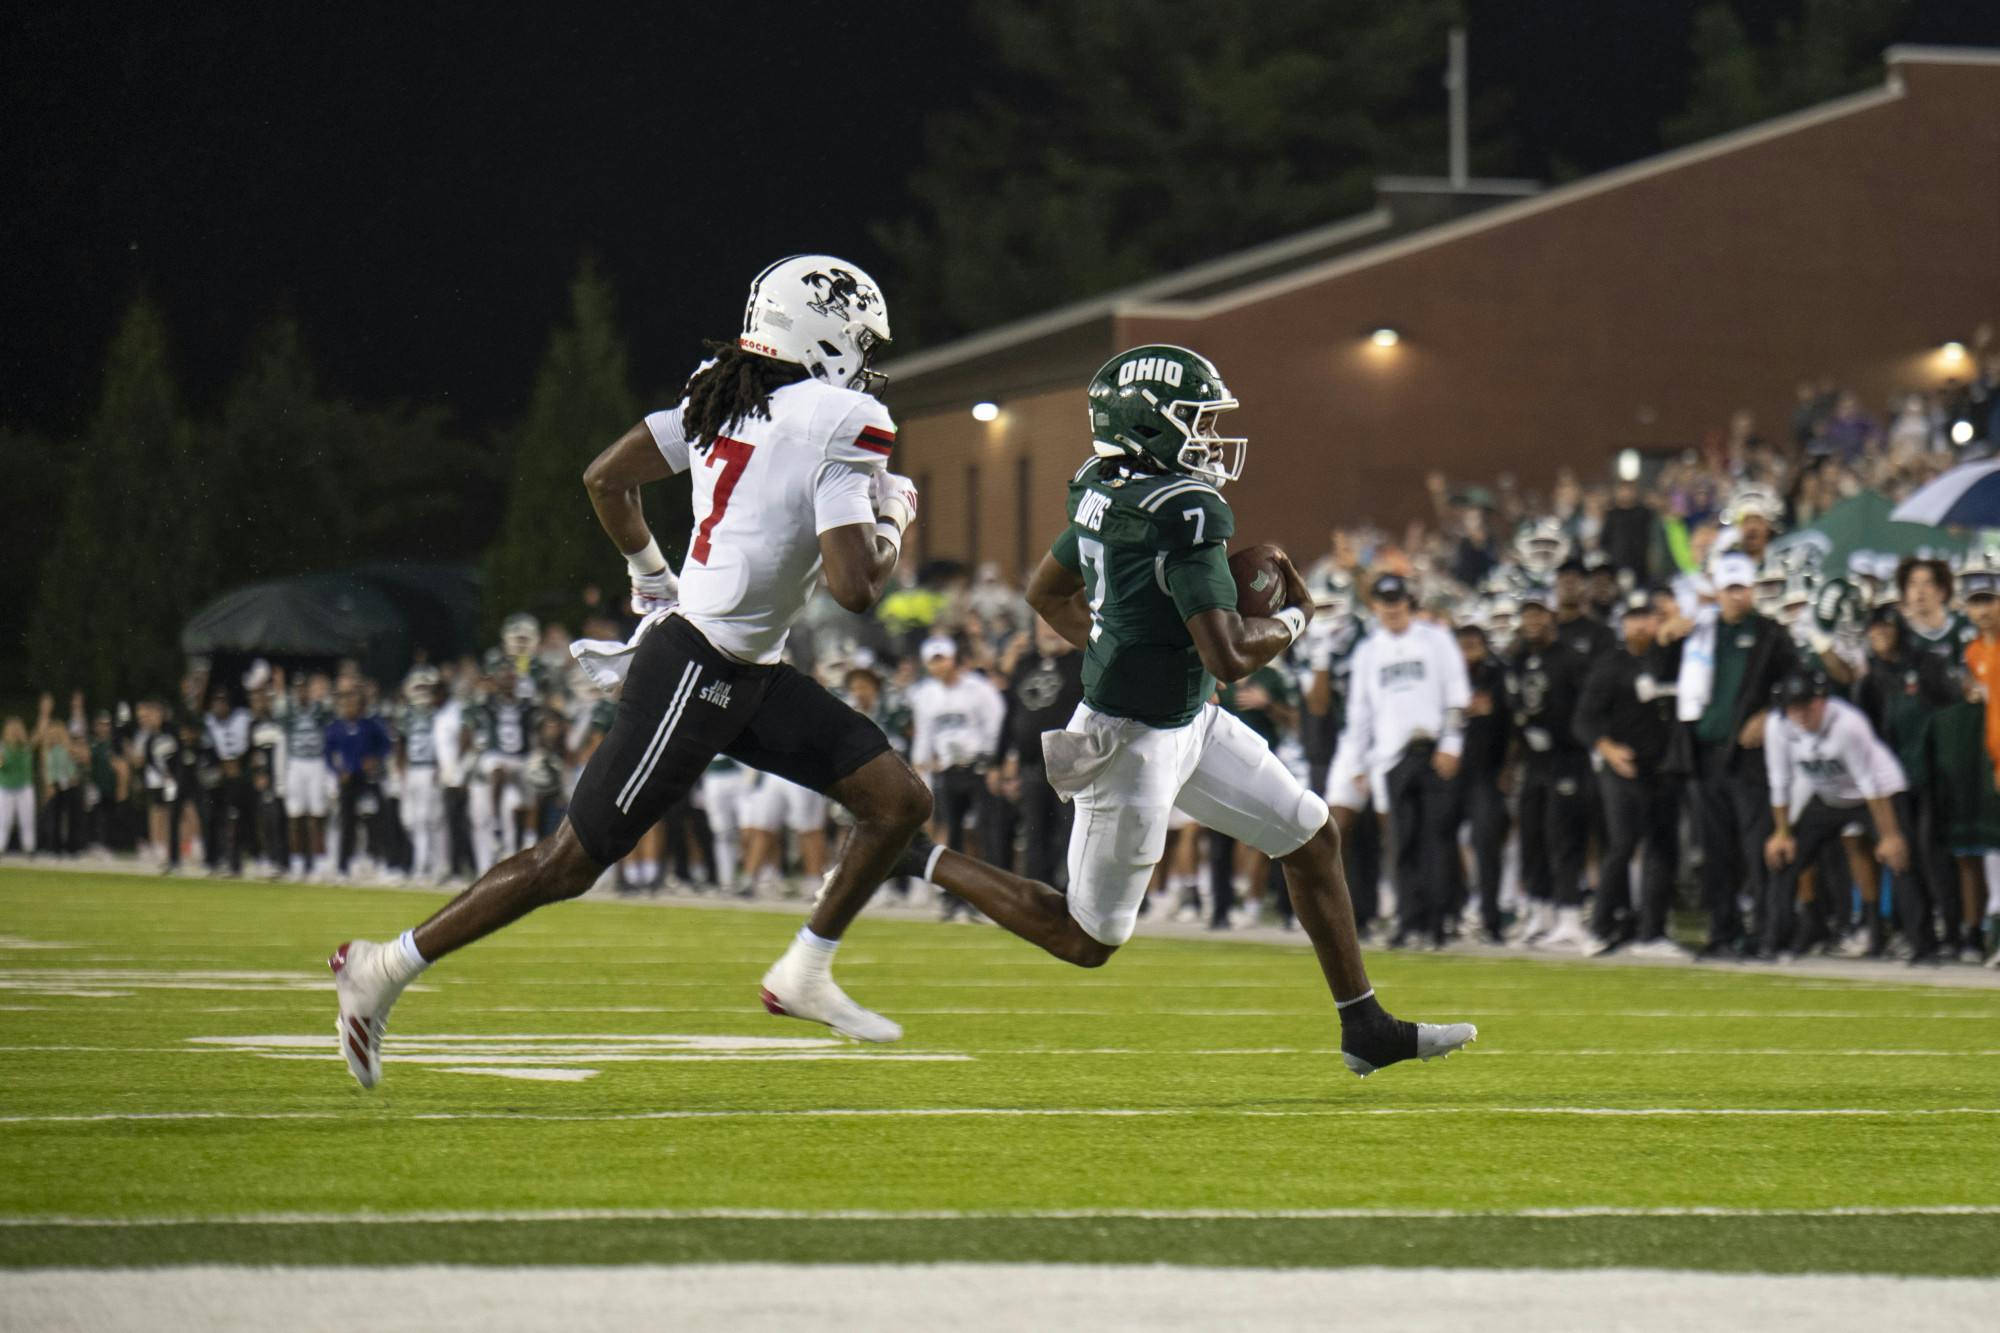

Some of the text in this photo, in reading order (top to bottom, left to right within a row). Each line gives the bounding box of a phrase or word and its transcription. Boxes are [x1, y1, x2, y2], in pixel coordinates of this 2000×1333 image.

[738, 338, 778, 358] COCKS
[1118, 357, 1184, 388] OHIO
[691, 434, 756, 566] 7
[1182, 507, 1206, 546] 7
[1078, 535, 1106, 644] 7
[699, 687, 731, 709] STATE
